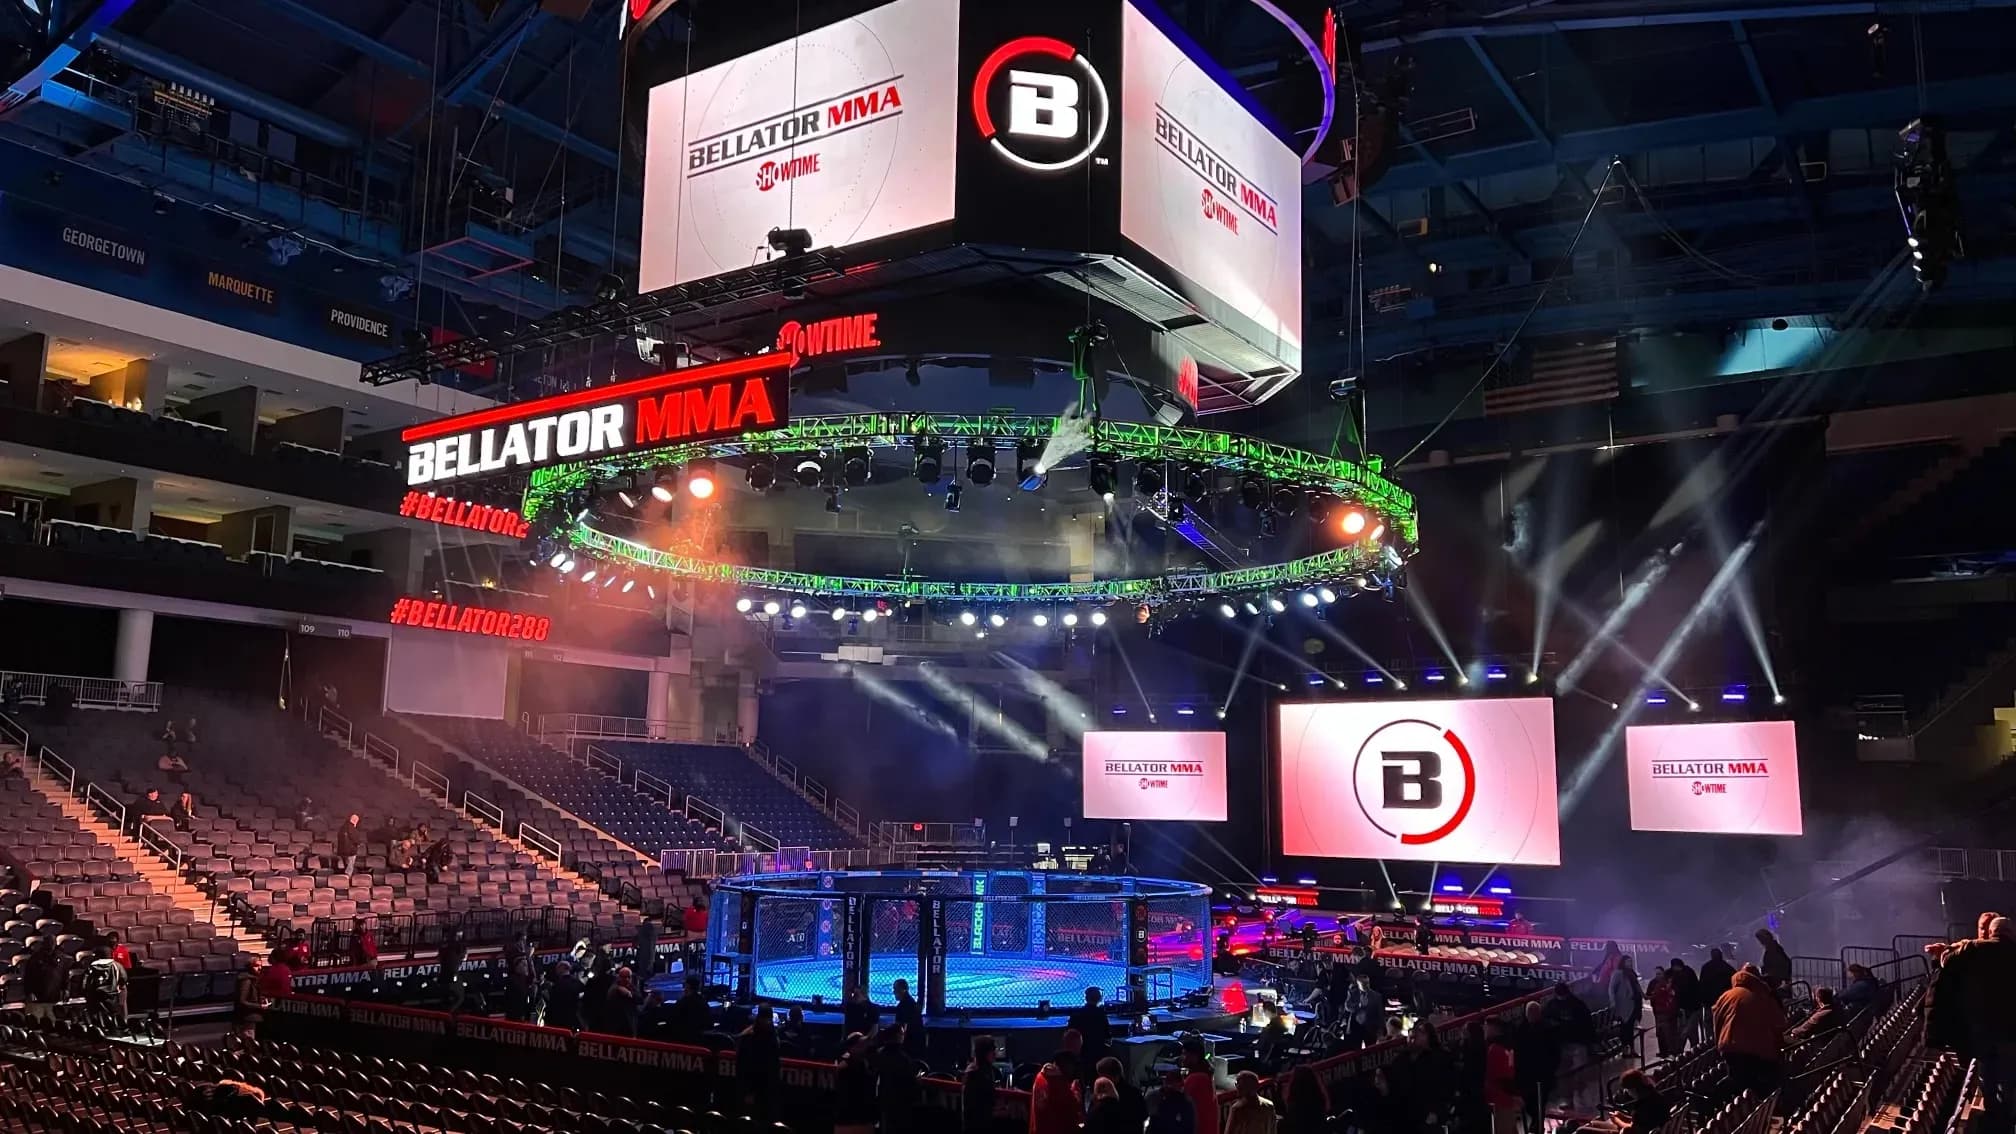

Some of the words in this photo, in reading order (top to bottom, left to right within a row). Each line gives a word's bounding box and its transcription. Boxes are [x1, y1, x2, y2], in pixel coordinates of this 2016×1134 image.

[1009, 70, 1078, 138] B
[689, 110, 820, 170] BELLATOR
[827, 85, 902, 128] MMA
[755, 153, 821, 191] SHOWTIME
[1155, 112, 1237, 197] BELLATOR
[1240, 182, 1277, 228] MMA
[1202, 189, 1238, 235] SHOWTIME
[62, 227, 145, 265] GEORGETOWN
[207, 271, 274, 304] MARQUETTE
[330, 308, 389, 338] PROVIDENCE
[776, 313, 880, 368] SHOWTIME
[407, 404, 625, 486] BELLATOR
[635, 378, 775, 443] MMA
[399, 490, 529, 538] #BELLATOR2
[301, 624, 315, 632] 109
[337, 629, 350, 637] 110
[390, 598, 550, 640] #BELLATOR288
[1105, 763, 1167, 772] BELLATOR
[1171, 764, 1202, 773] MMA
[1139, 778, 1168, 790] SHOWTIME
[1380, 750, 1442, 808] B
[1653, 763, 1724, 775] BELLATOR
[1729, 762, 1768, 774] MMA
[1692, 781, 1727, 795] SHOWTIME
[972, 879, 985, 950] BLACKHWK
[1434, 903, 1479, 915] BELLOR
[654, 943, 681, 953] MMA
[846, 896, 857, 969] BELLATOR
[932, 899, 942, 974] BELLATOR
[1384, 930, 1415, 940] ELLAT
[1470, 935, 1528, 948] BELLATOR
[1530, 940, 1562, 950] MMA
[330, 970, 371, 985] MMA
[1377, 957, 1441, 971] BELLATOR
[1443, 962, 1478, 975] MMA
[1489, 965, 1566, 981] BELLATOR
[349, 1007, 412, 1029] BELLATOR
[413, 1016, 448, 1035] MMA
[456, 1022, 527, 1046] BELLATOR
[528, 1034, 568, 1053] MMA
[577, 1041, 657, 1066] BELLATOR
[658, 1050, 705, 1073] MMA
